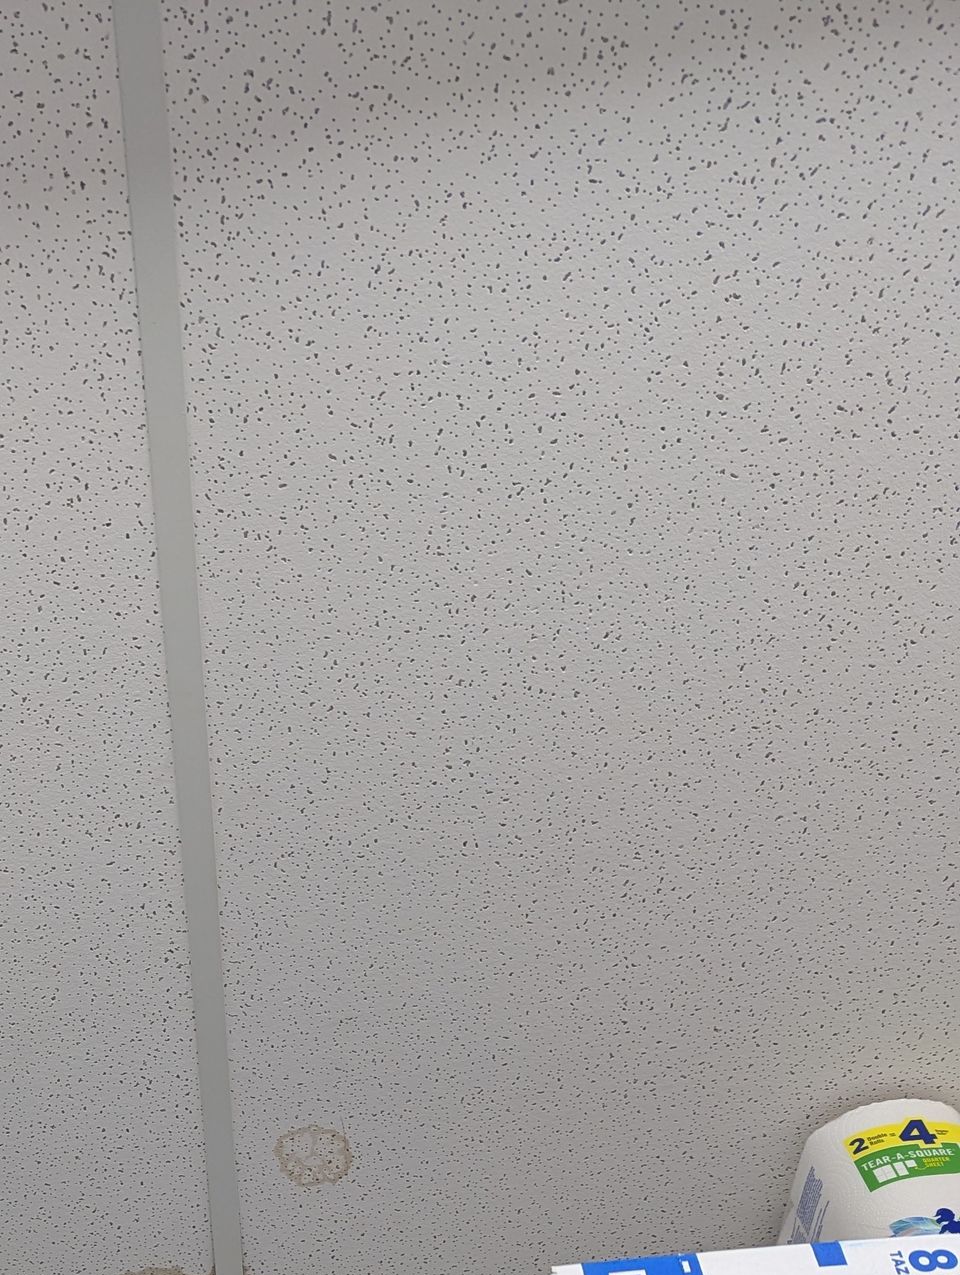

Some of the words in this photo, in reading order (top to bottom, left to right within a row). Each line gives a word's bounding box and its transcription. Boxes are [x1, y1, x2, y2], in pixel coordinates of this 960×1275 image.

[899, 1119, 938, 1145] 4
[848, 1138, 870, 1155] 2
[861, 1148, 955, 1171] TEAR-A-SQUARE
[908, 1249, 959, 1273] 8
